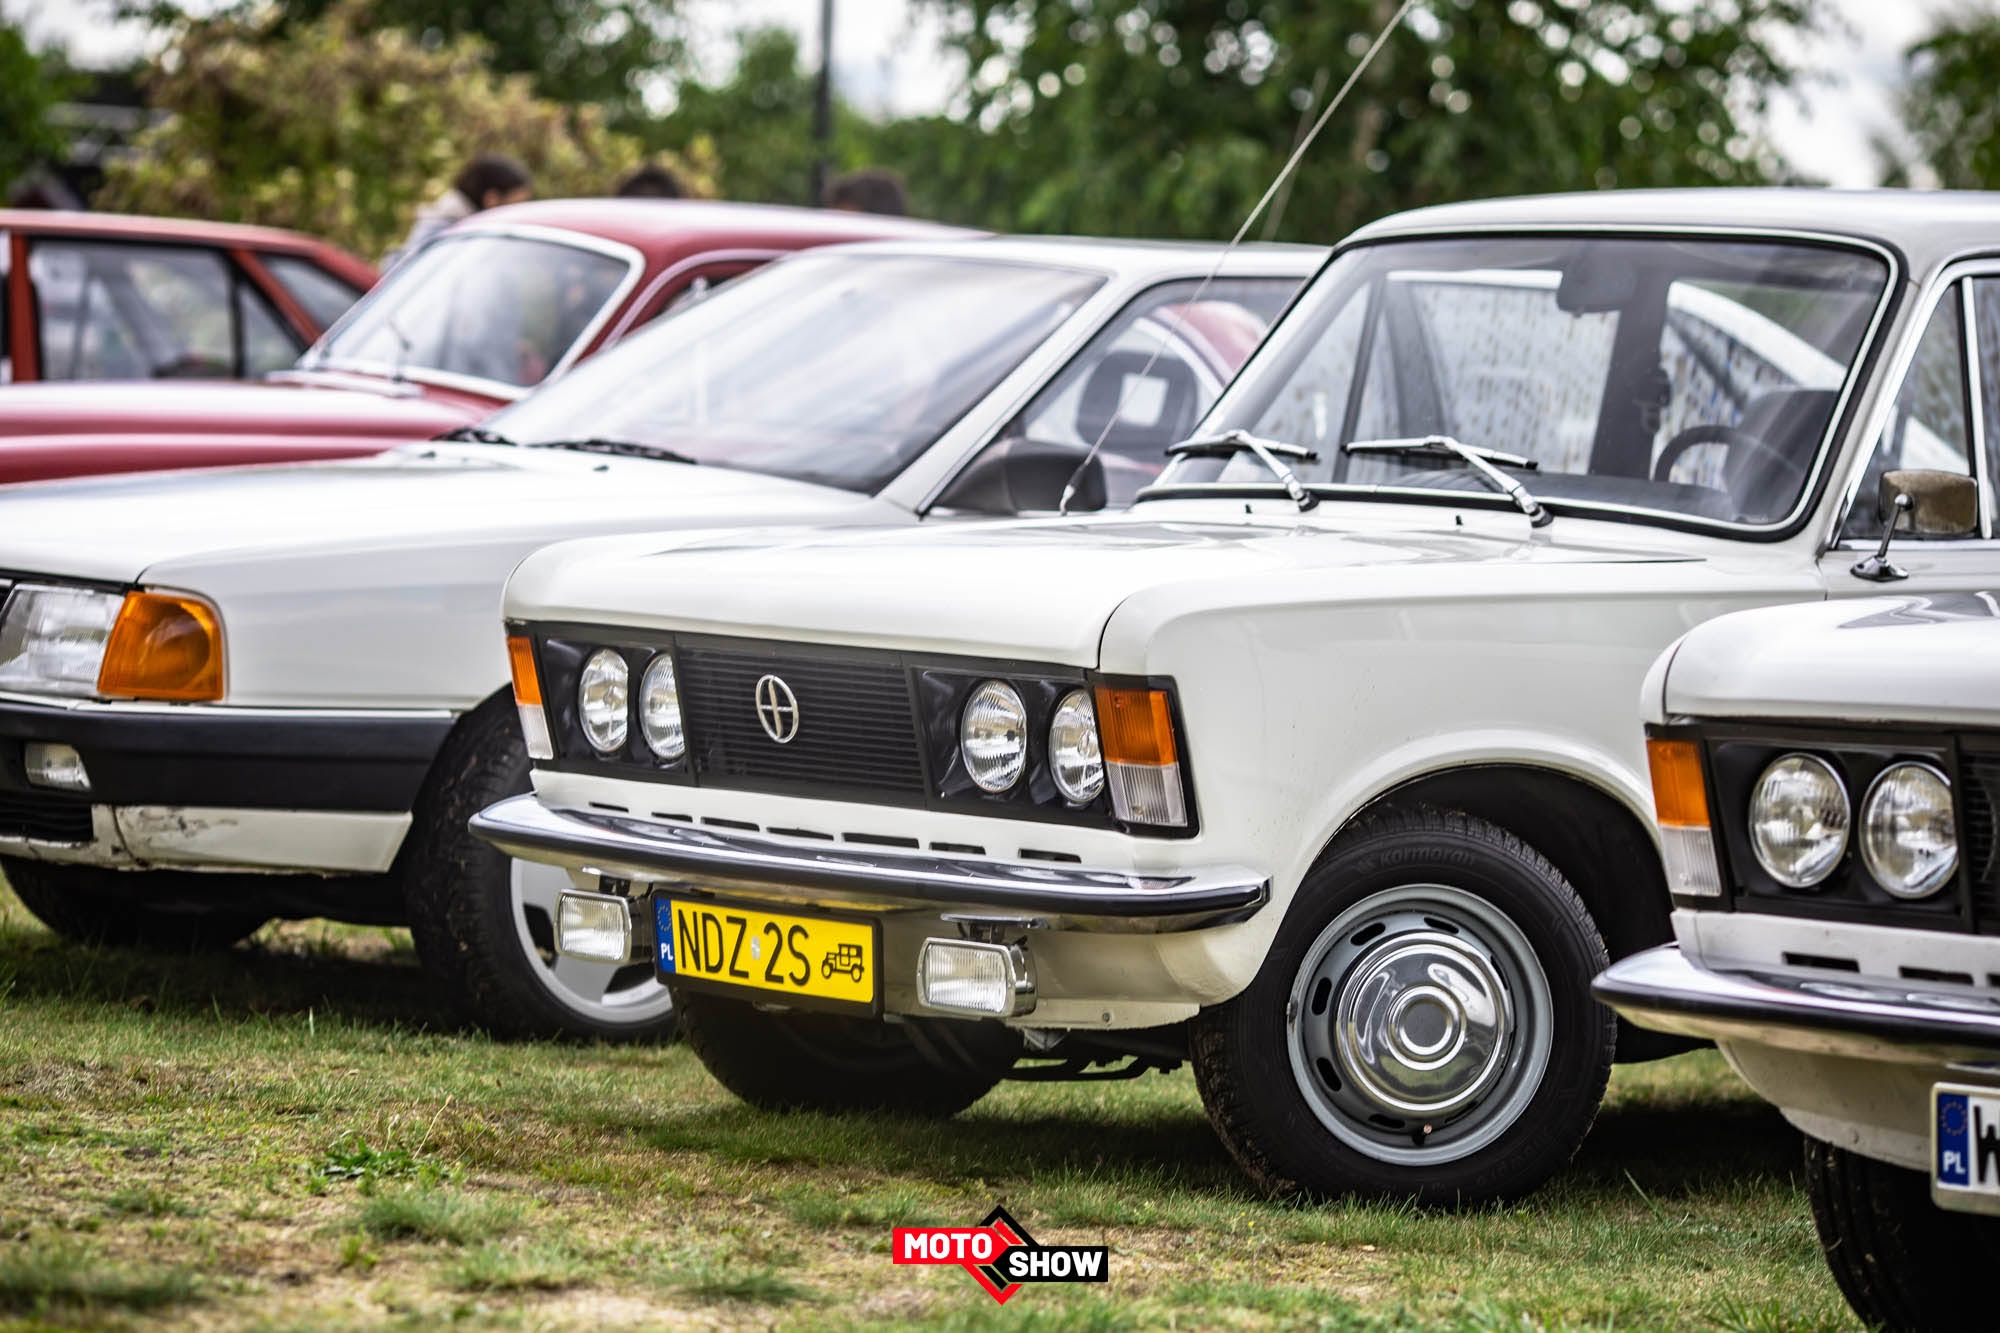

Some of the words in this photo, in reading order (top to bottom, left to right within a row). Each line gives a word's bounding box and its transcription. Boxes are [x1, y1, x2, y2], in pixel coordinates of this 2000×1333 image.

[661, 942, 674, 960] PL
[678, 908, 749, 979] NDZ
[763, 921, 811, 987] 2S
[1942, 1151, 1966, 1175] PL
